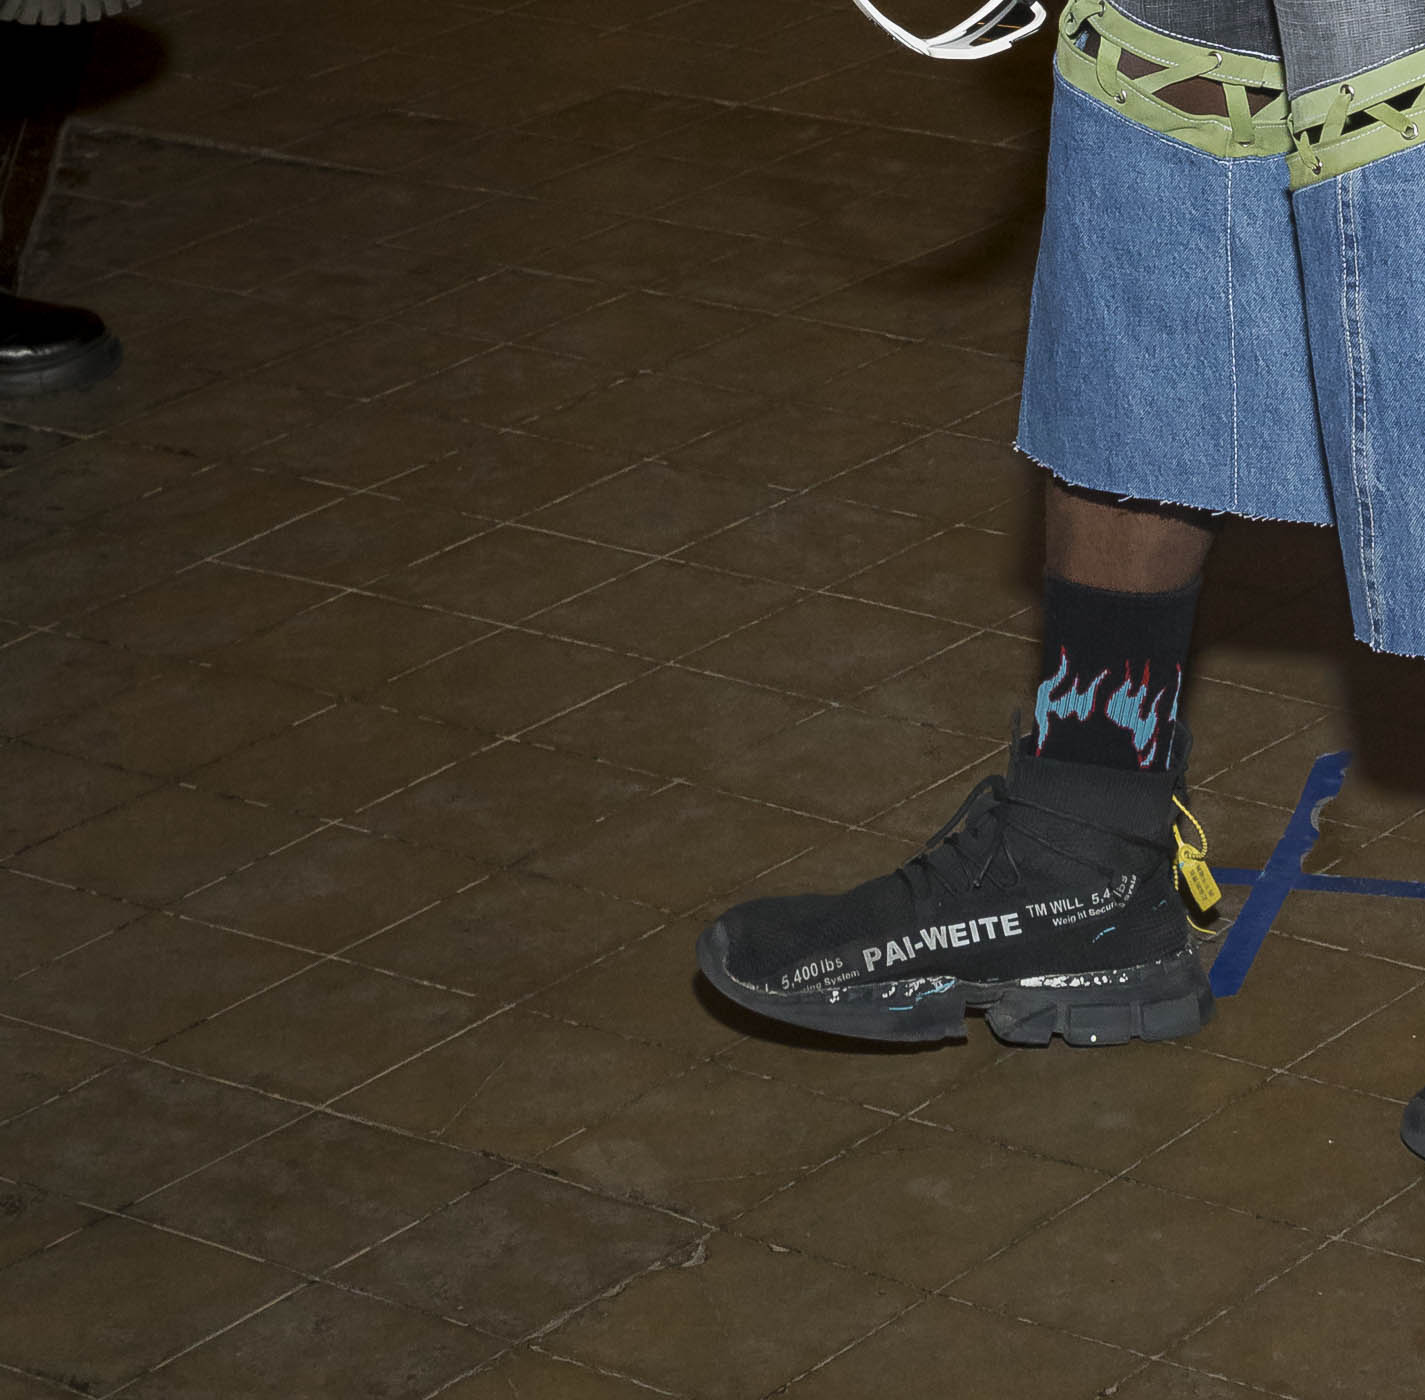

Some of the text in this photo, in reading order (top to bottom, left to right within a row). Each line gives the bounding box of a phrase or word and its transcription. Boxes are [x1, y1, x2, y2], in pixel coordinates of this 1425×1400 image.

[862, 912, 1023, 973] PAI-WEITE
[1025, 903, 1048, 918] TM
[1049, 897, 1084, 915] WILL
[781, 962, 819, 990] 5,400
[820, 957, 844, 974] lbs
